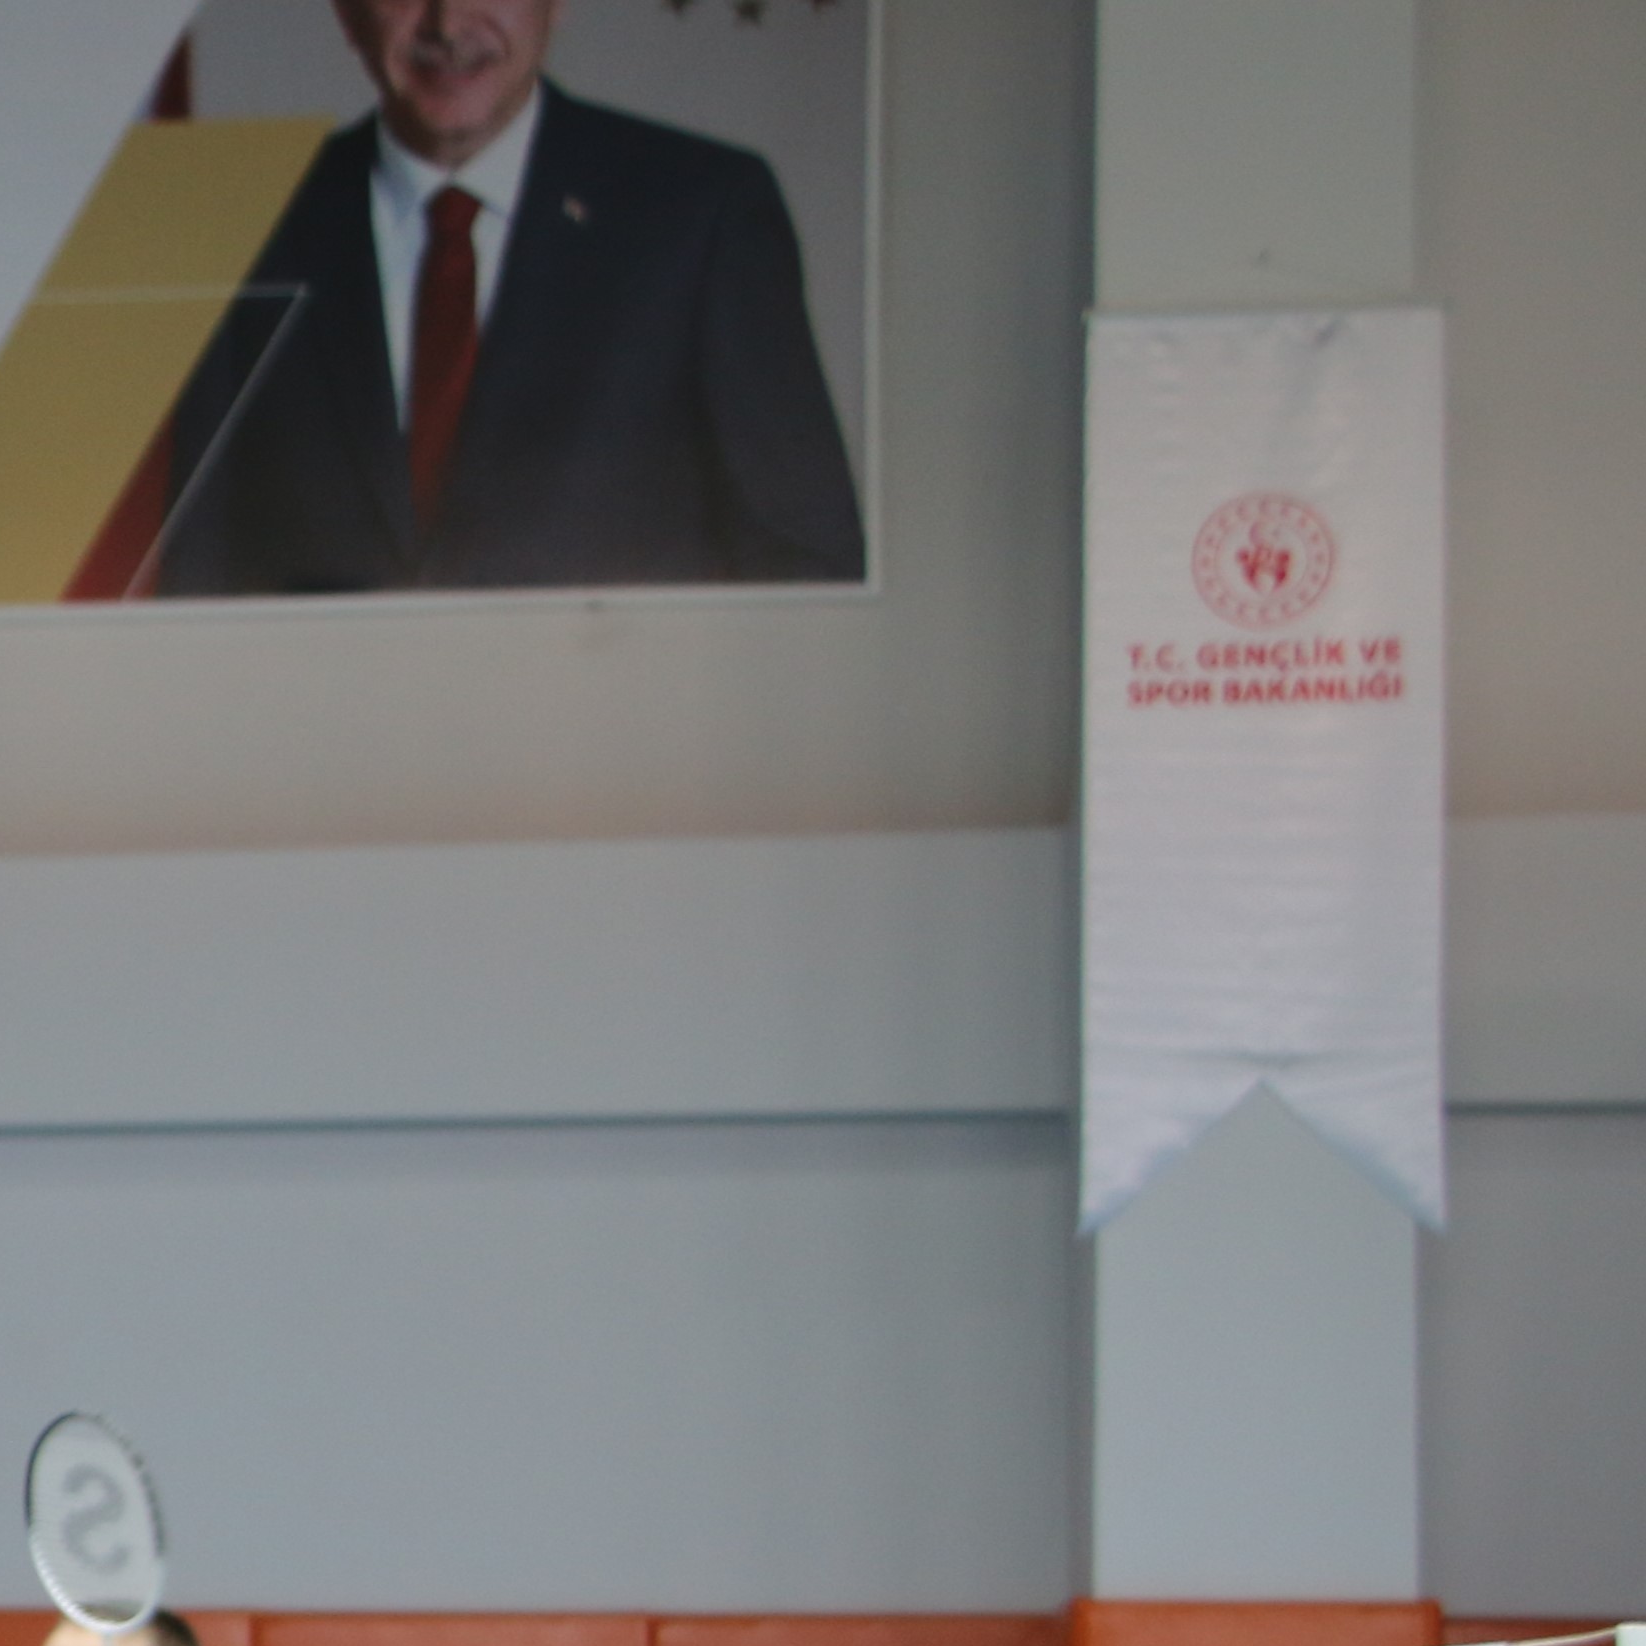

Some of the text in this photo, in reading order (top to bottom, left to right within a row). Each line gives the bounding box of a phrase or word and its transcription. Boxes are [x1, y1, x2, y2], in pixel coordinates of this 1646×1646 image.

[1127, 635, 1403, 675] T.C. GENÇLİK VE
[1127, 671, 1406, 708] SPOR BAKANLIĞI
